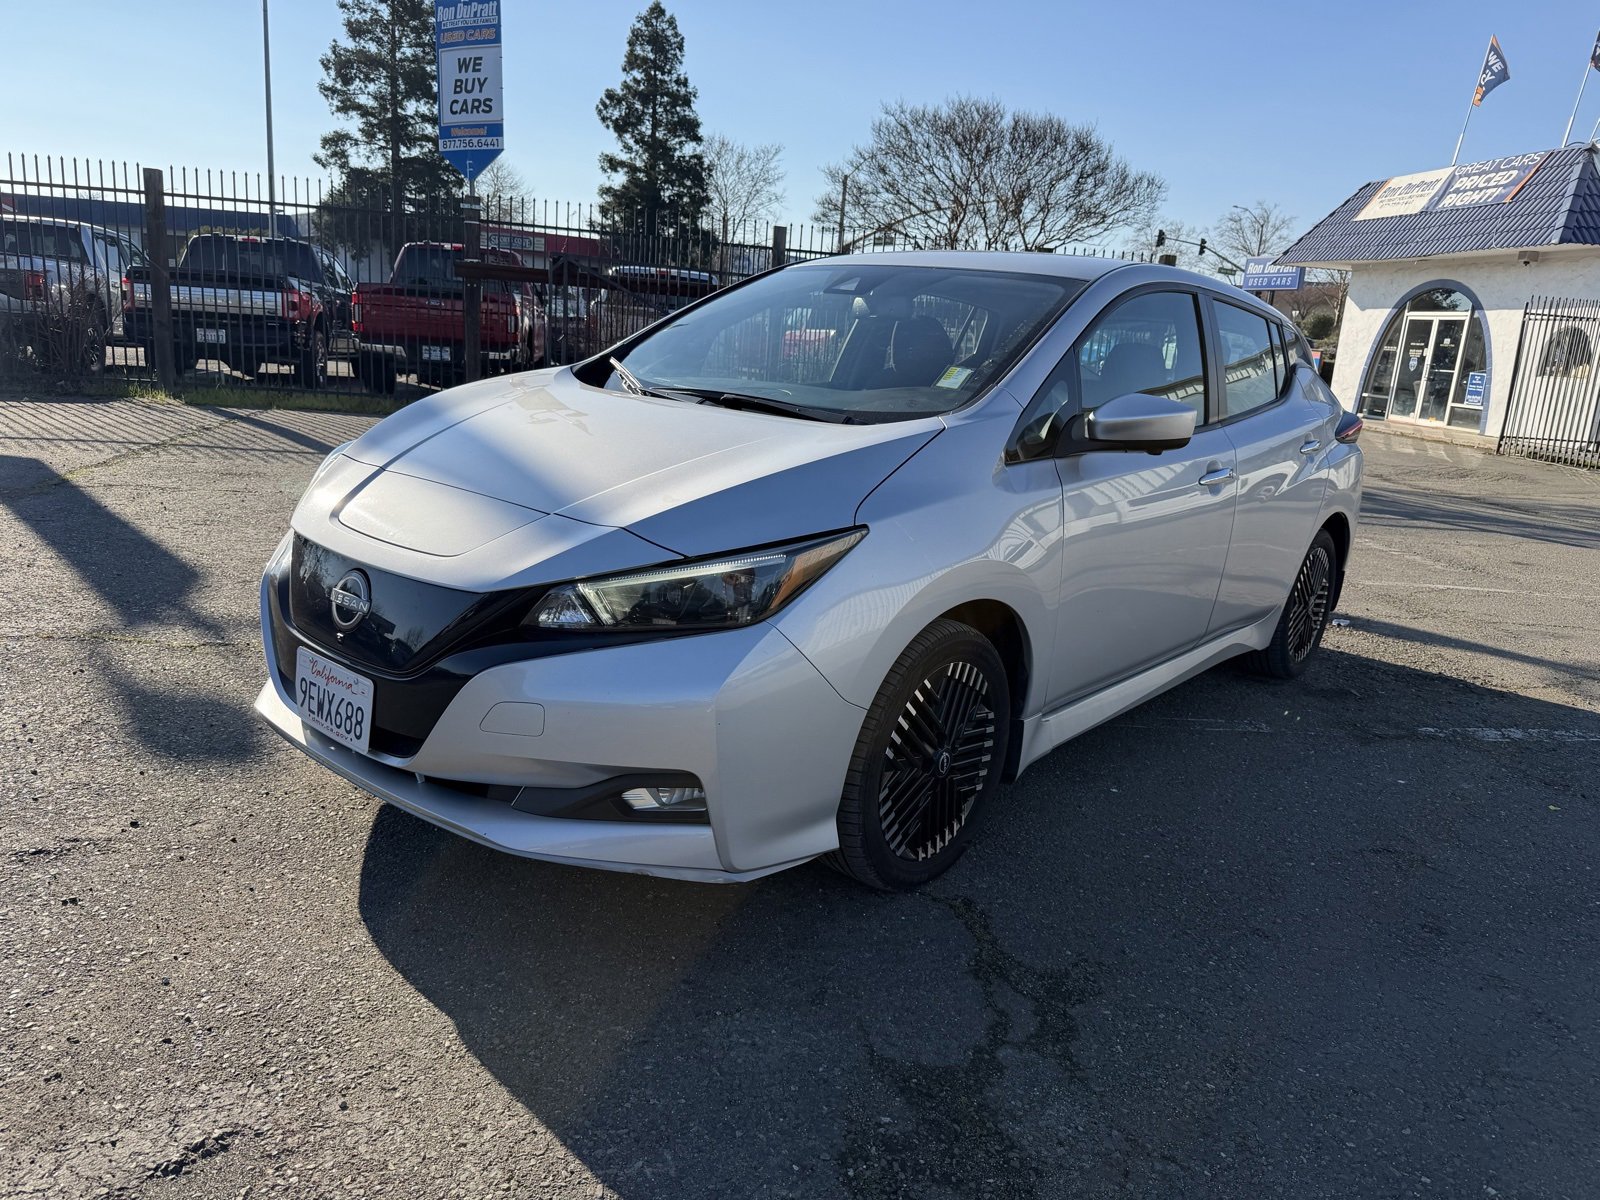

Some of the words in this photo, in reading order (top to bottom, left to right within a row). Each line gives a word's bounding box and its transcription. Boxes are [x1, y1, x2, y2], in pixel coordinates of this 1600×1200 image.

[437, 6, 455, 22] Ron
[456, 1, 498, 18] DuPratt
[440, 30, 465, 44] USED
[466, 28, 496, 41] CARS
[457, 57, 483, 73] WE
[1488, 51, 1505, 73] WE
[453, 77, 488, 94] BUY
[450, 98, 493, 115] CARS
[442, 139, 500, 149] 877.756.6441
[1455, 158, 1503, 176] GREAT
[1501, 152, 1545, 169] CARS
[1450, 170, 1518, 191] PRICED
[1378, 186, 1402, 199] Ron
[1439, 187, 1504, 207] RIGHT!
[1247, 263, 1263, 274] Ron
[1248, 277, 1268, 286] USED
[1271, 276, 1292, 286] CARS
[311, 659, 357, 695] California
[300, 677, 364, 740] 9EWX688
[312, 716, 348, 740] dmv.ca.gov
